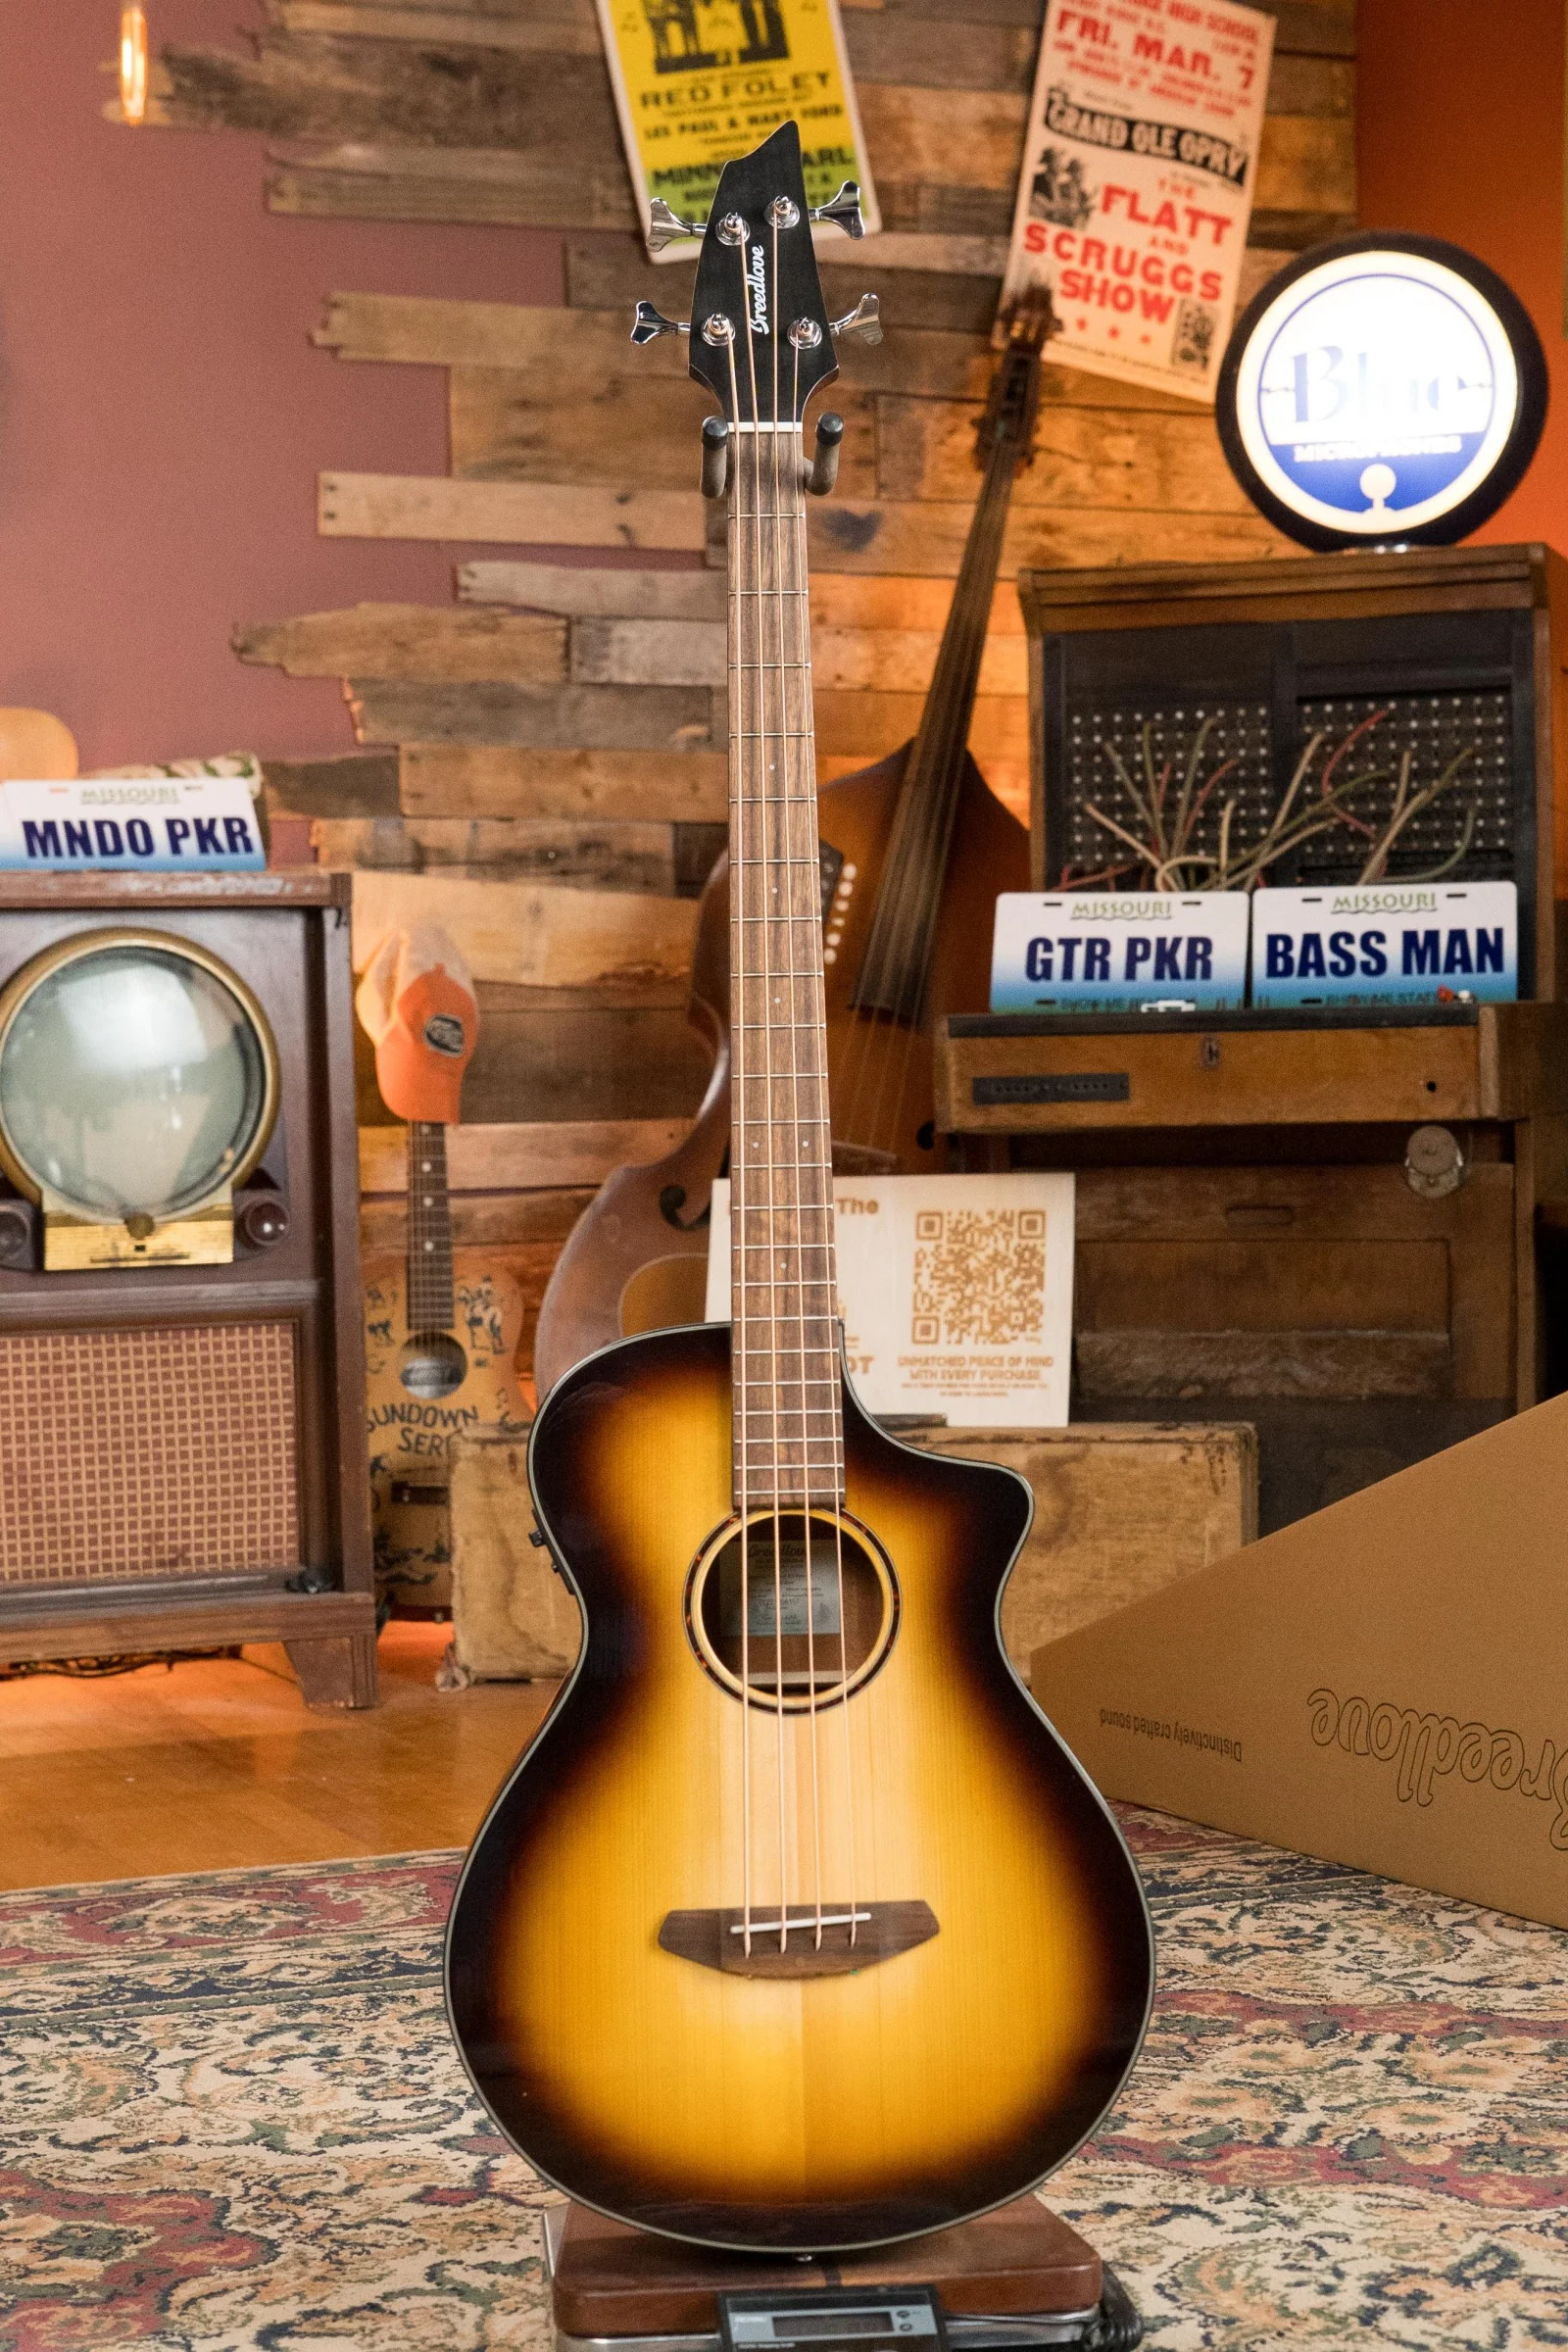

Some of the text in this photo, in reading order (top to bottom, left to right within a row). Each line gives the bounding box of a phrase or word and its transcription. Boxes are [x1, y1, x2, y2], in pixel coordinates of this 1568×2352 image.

[721, 71, 829, 98] FOLEY
[1048, 101, 1129, 149] GRAND
[1132, 119, 1176, 158] OLE
[1179, 131, 1246, 180] OPRY
[1101, 184, 1232, 245] FLATT
[1023, 222, 1222, 302] SCRUGGS
[747, 245, 769, 334] Breedlove
[1058, 269, 1176, 324] SHOW
[22, 817, 254, 858] MNDO PKR
[1071, 902, 1172, 919] MISSOURI
[1332, 893, 1437, 912] MISSOURI
[1025, 936, 1213, 982] GTR PKR
[1265, 927, 1504, 979] BASS MAN
[836, 1197, 879, 1215] The
[1100, 1709, 1242, 1762] Distinctively crafted sound
